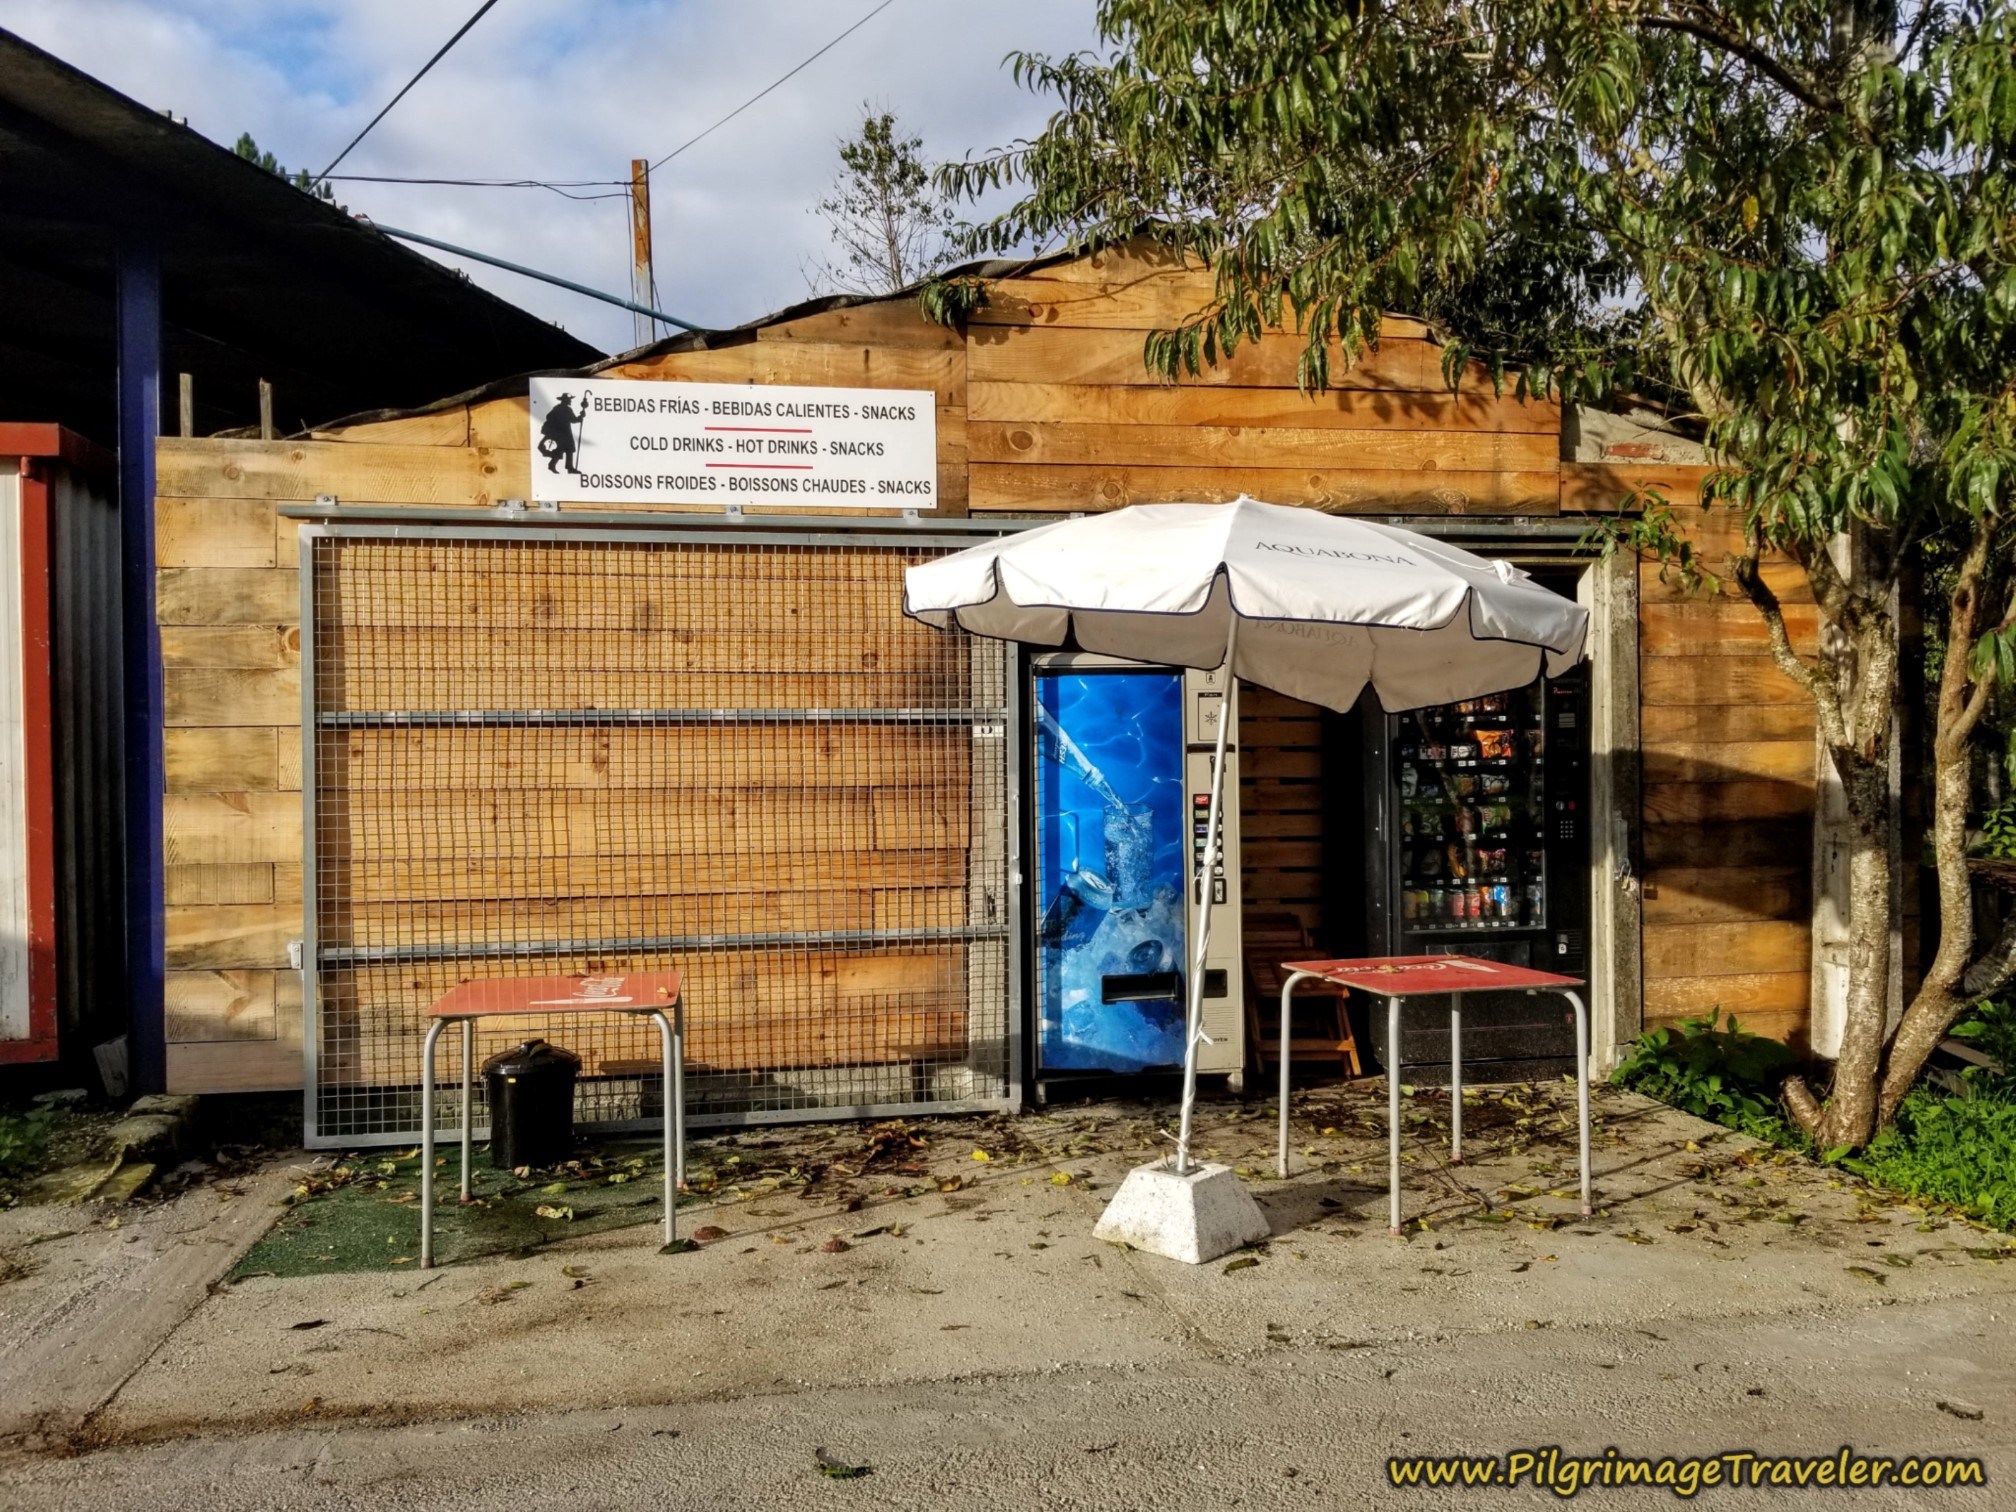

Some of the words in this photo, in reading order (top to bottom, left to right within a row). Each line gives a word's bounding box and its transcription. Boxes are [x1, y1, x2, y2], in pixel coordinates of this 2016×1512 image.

[594, 397, 656, 414] BEBIDAS
[659, 396, 700, 415] FRÍAS
[712, 400, 772, 417] BEBIDAS
[775, 402, 850, 419] CALIENTES
[861, 405, 916, 421] SNACKS
[630, 435, 669, 451] COLD
[672, 437, 724, 453] DRINKS
[736, 439, 764, 454] HOT
[768, 439, 818, 455] DRINKS
[830, 441, 884, 457] SNACKS
[580, 473, 653, 490] BOISSONS
[657, 475, 717, 491] FROIDES
[729, 476, 798, 492] BOISSONS
[802, 478, 866, 494] CHAUDES
[878, 480, 931, 495] SNACKS
[1255, 540, 1417, 567] AQUABONA
